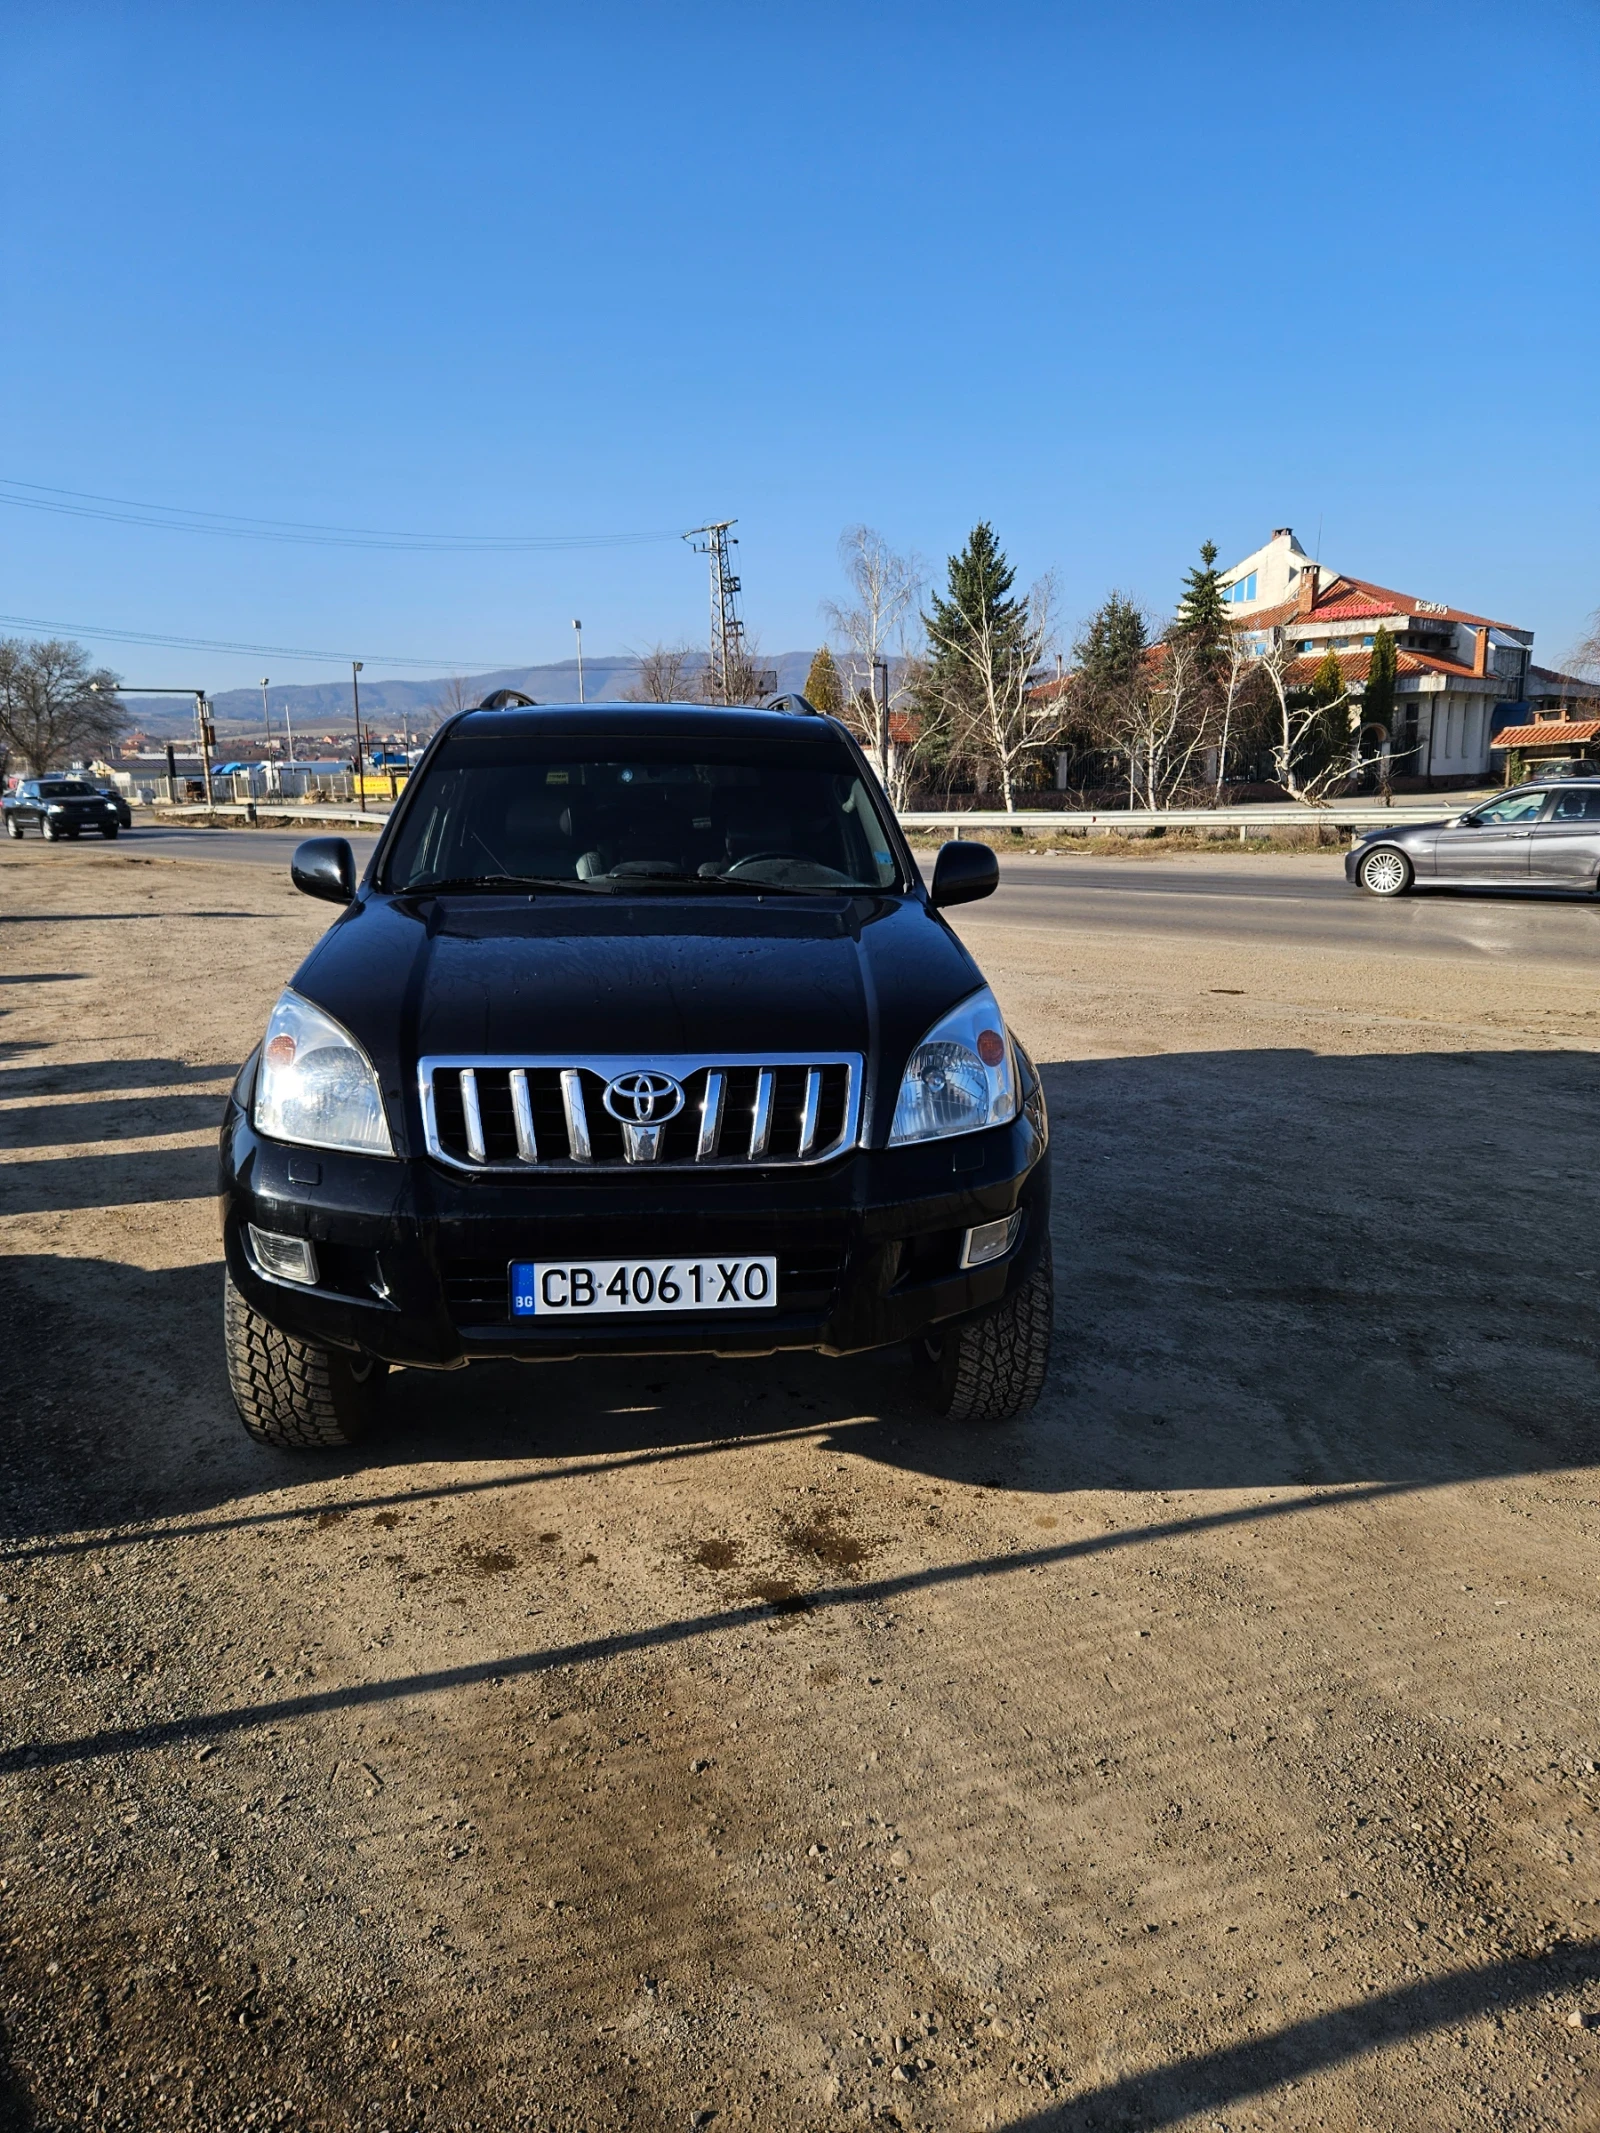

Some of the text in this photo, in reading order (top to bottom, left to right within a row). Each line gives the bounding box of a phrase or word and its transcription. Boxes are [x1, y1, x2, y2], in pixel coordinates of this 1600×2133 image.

[1315, 602, 1395, 618] RESTAURANT
[541, 1262, 768, 1307] CB 4061 XO
[515, 1295, 533, 1308] BG
